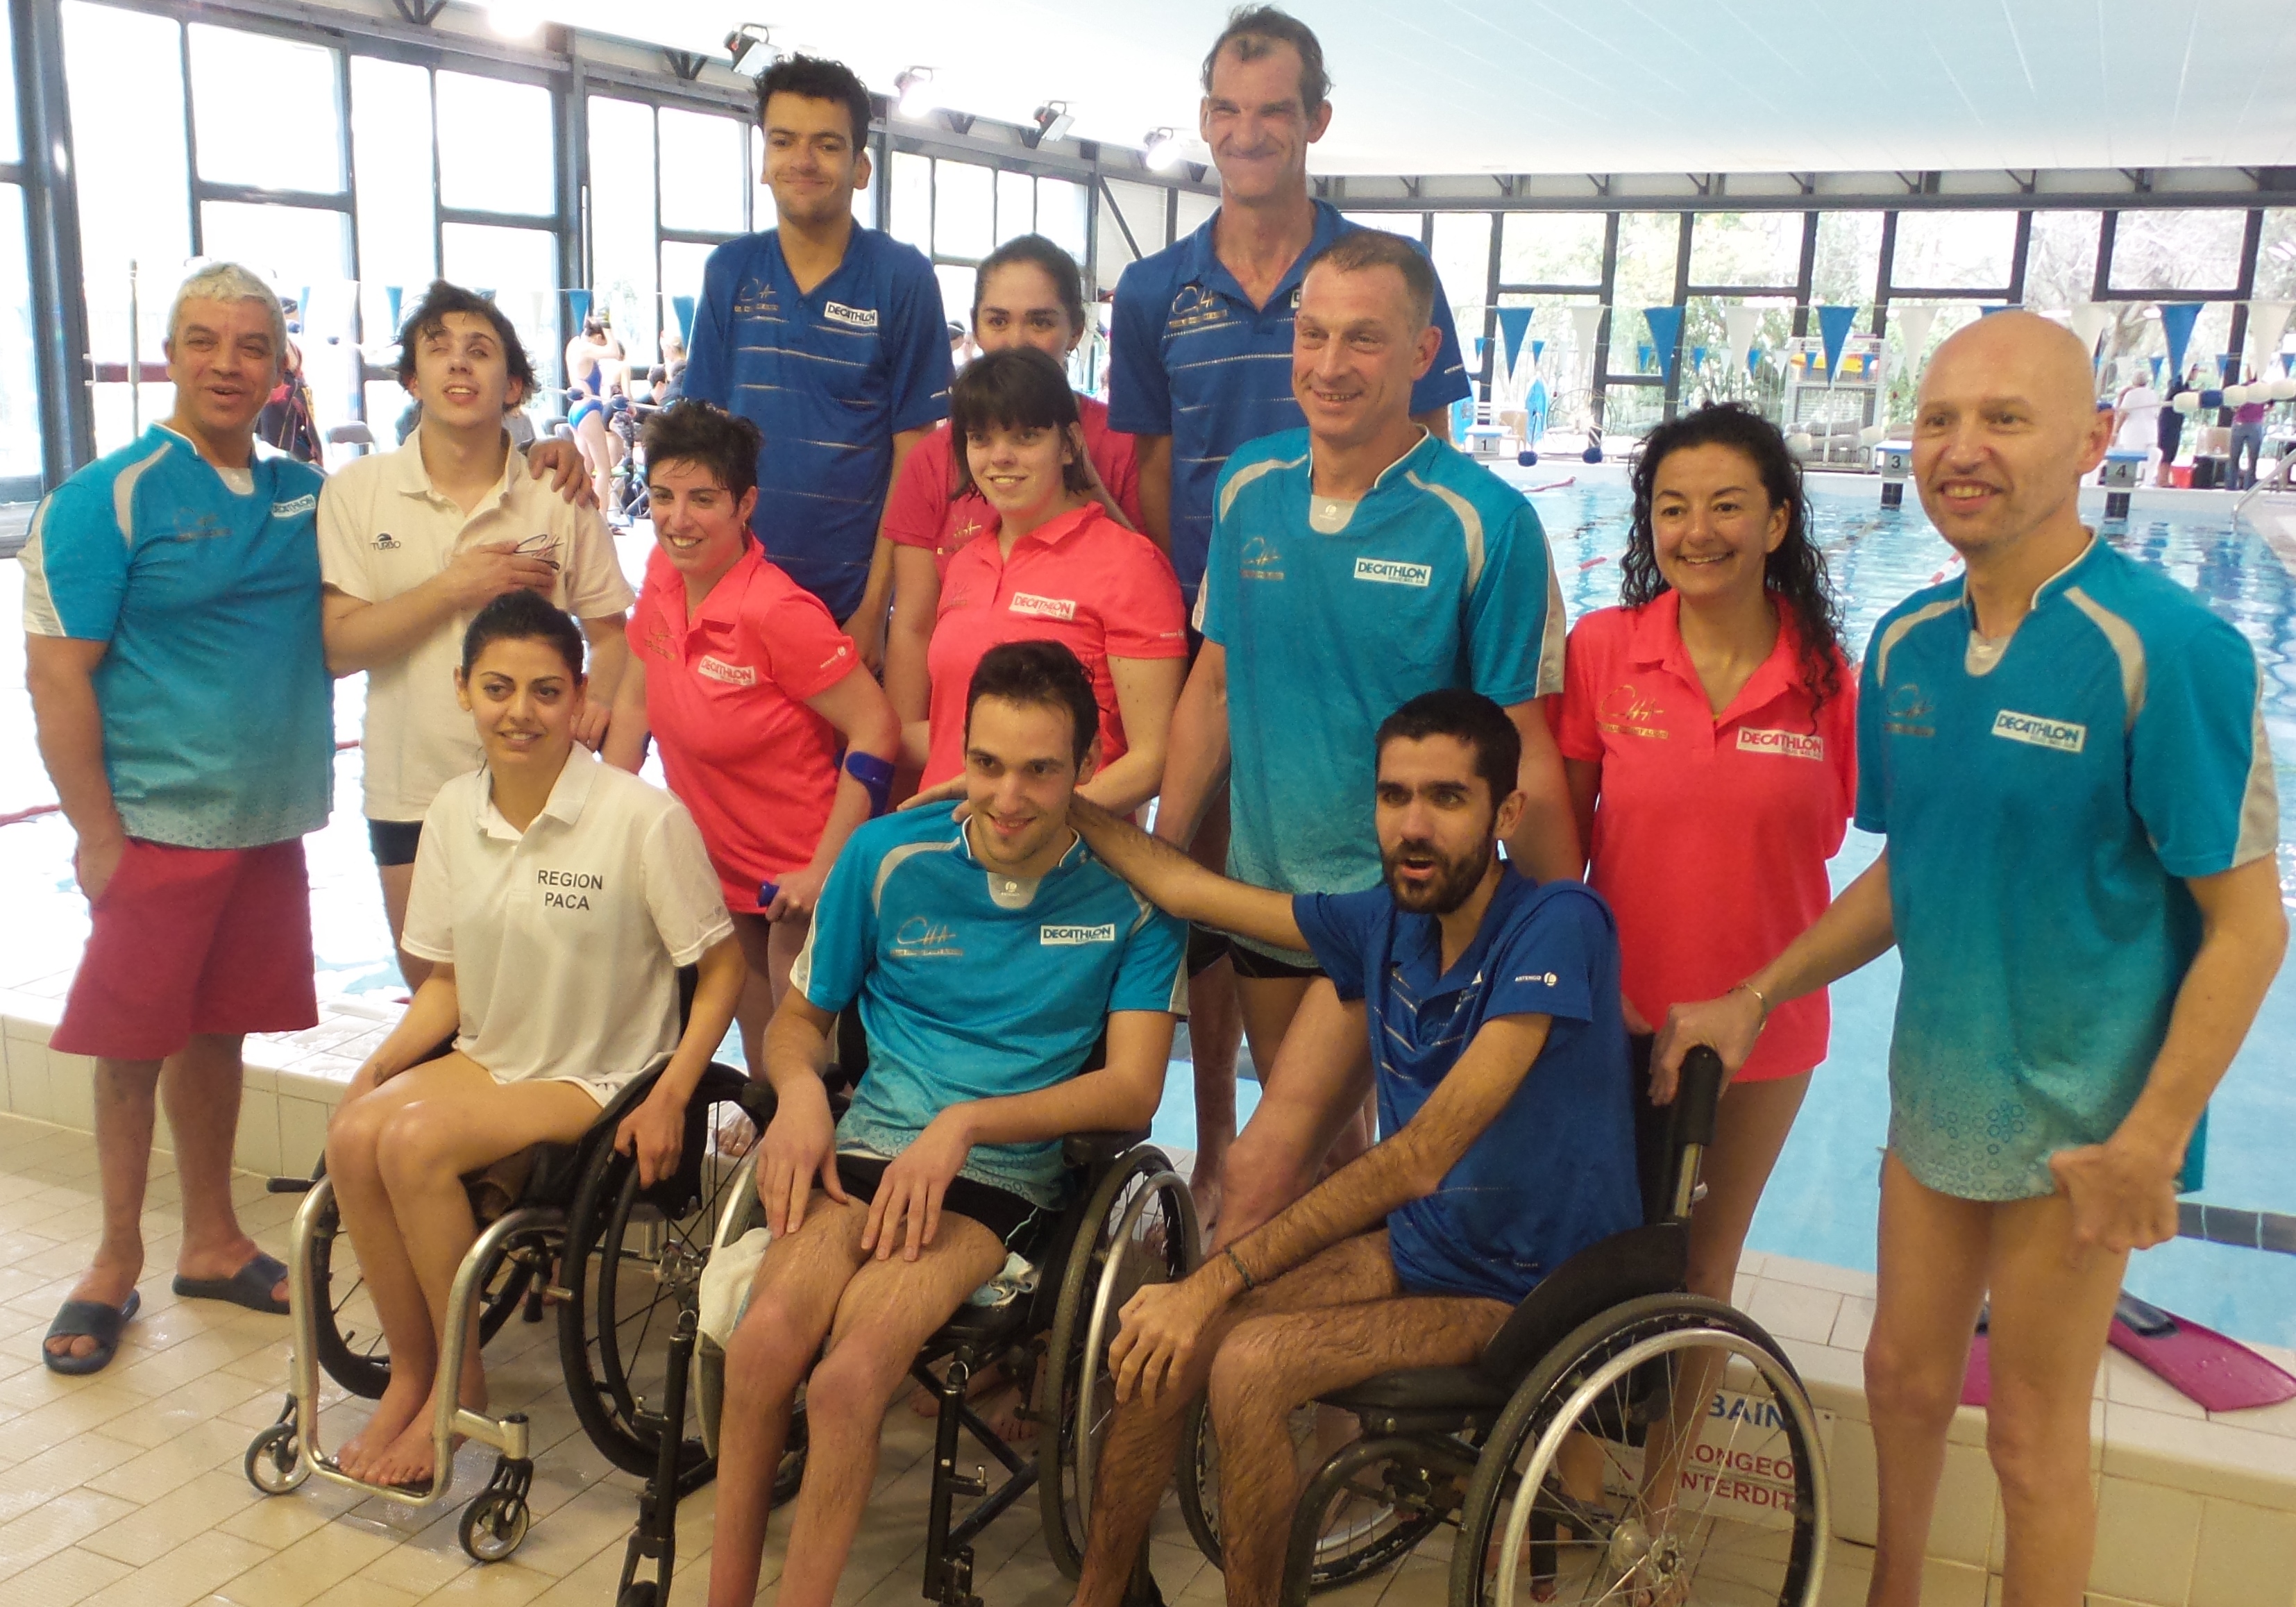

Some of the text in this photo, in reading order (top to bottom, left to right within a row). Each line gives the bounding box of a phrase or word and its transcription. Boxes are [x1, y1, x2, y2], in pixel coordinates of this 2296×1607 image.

[827, 304, 876, 322] DECATHLON
[1480, 439, 1487, 451] 1
[1891, 455, 1901, 469] 3
[2115, 464, 2127, 478] 4
[369, 541, 402, 550] TURBO
[1358, 561, 1427, 580] DECATHLON
[1014, 595, 1072, 614] DECATHLON
[700, 656, 752, 680] DECATHLON
[1996, 714, 2080, 743] DECATHLON
[1740, 730, 1823, 753] DECATHLON
[537, 869, 603, 890] REGION
[544, 892, 590, 911] PACA
[1043, 926, 1111, 939] DECATHLON
[1689, 1443, 1796, 1480] ONGEO
[1680, 1471, 1796, 1512] NTERDIT
